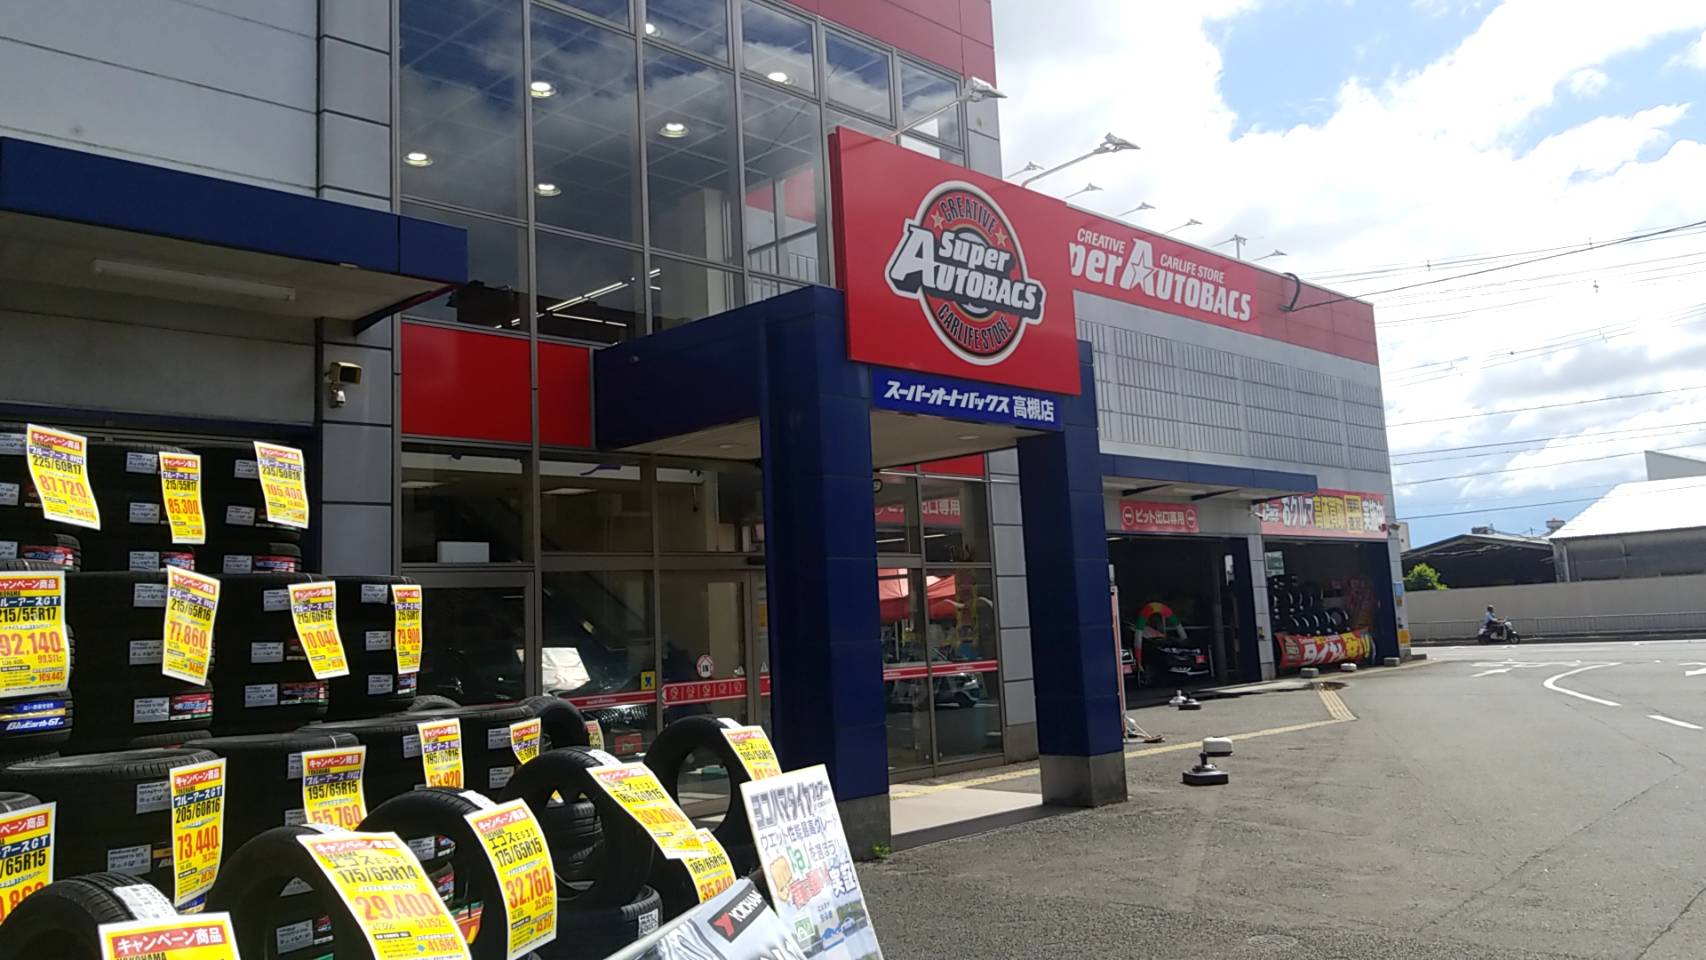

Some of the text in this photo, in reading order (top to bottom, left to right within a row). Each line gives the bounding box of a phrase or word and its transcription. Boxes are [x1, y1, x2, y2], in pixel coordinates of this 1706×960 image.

[940, 196, 996, 233] CREATIVE
[939, 231, 1011, 273] Super
[1077, 228, 1126, 254] CREATIVE
[890, 225, 1038, 310] AUTOBACS
[1119, 238, 1251, 321] AUTOBACS
[1160, 254, 1226, 284] CARLIFE STORE
[938, 303, 1012, 350] CARLIFE STORE
[883, 380, 1055, 422] スーパーオートバックス 高槻店
[32, 431, 81, 451] キャンペーン商品
[33, 455, 82, 475] 225/60R17
[1135, 508, 1185, 525] ピット出口専用
[171, 598, 211, 622] 215/65R16
[309, 754, 359, 768] キャンペーン商品
[176, 768, 220, 786] キャンペーン商品
[308, 780, 358, 800] 195/65R15
[176, 798, 221, 824] 205/60R16
[312, 804, 362, 827] 55760
[494, 837, 543, 868] 175/65R15
[337, 864, 418, 884] 175/65R14
[505, 866, 552, 909] 32,760
[700, 875, 734, 901] 35840
[355, 892, 441, 921] 29,400
[117, 927, 223, 954] キャンペーン商品
